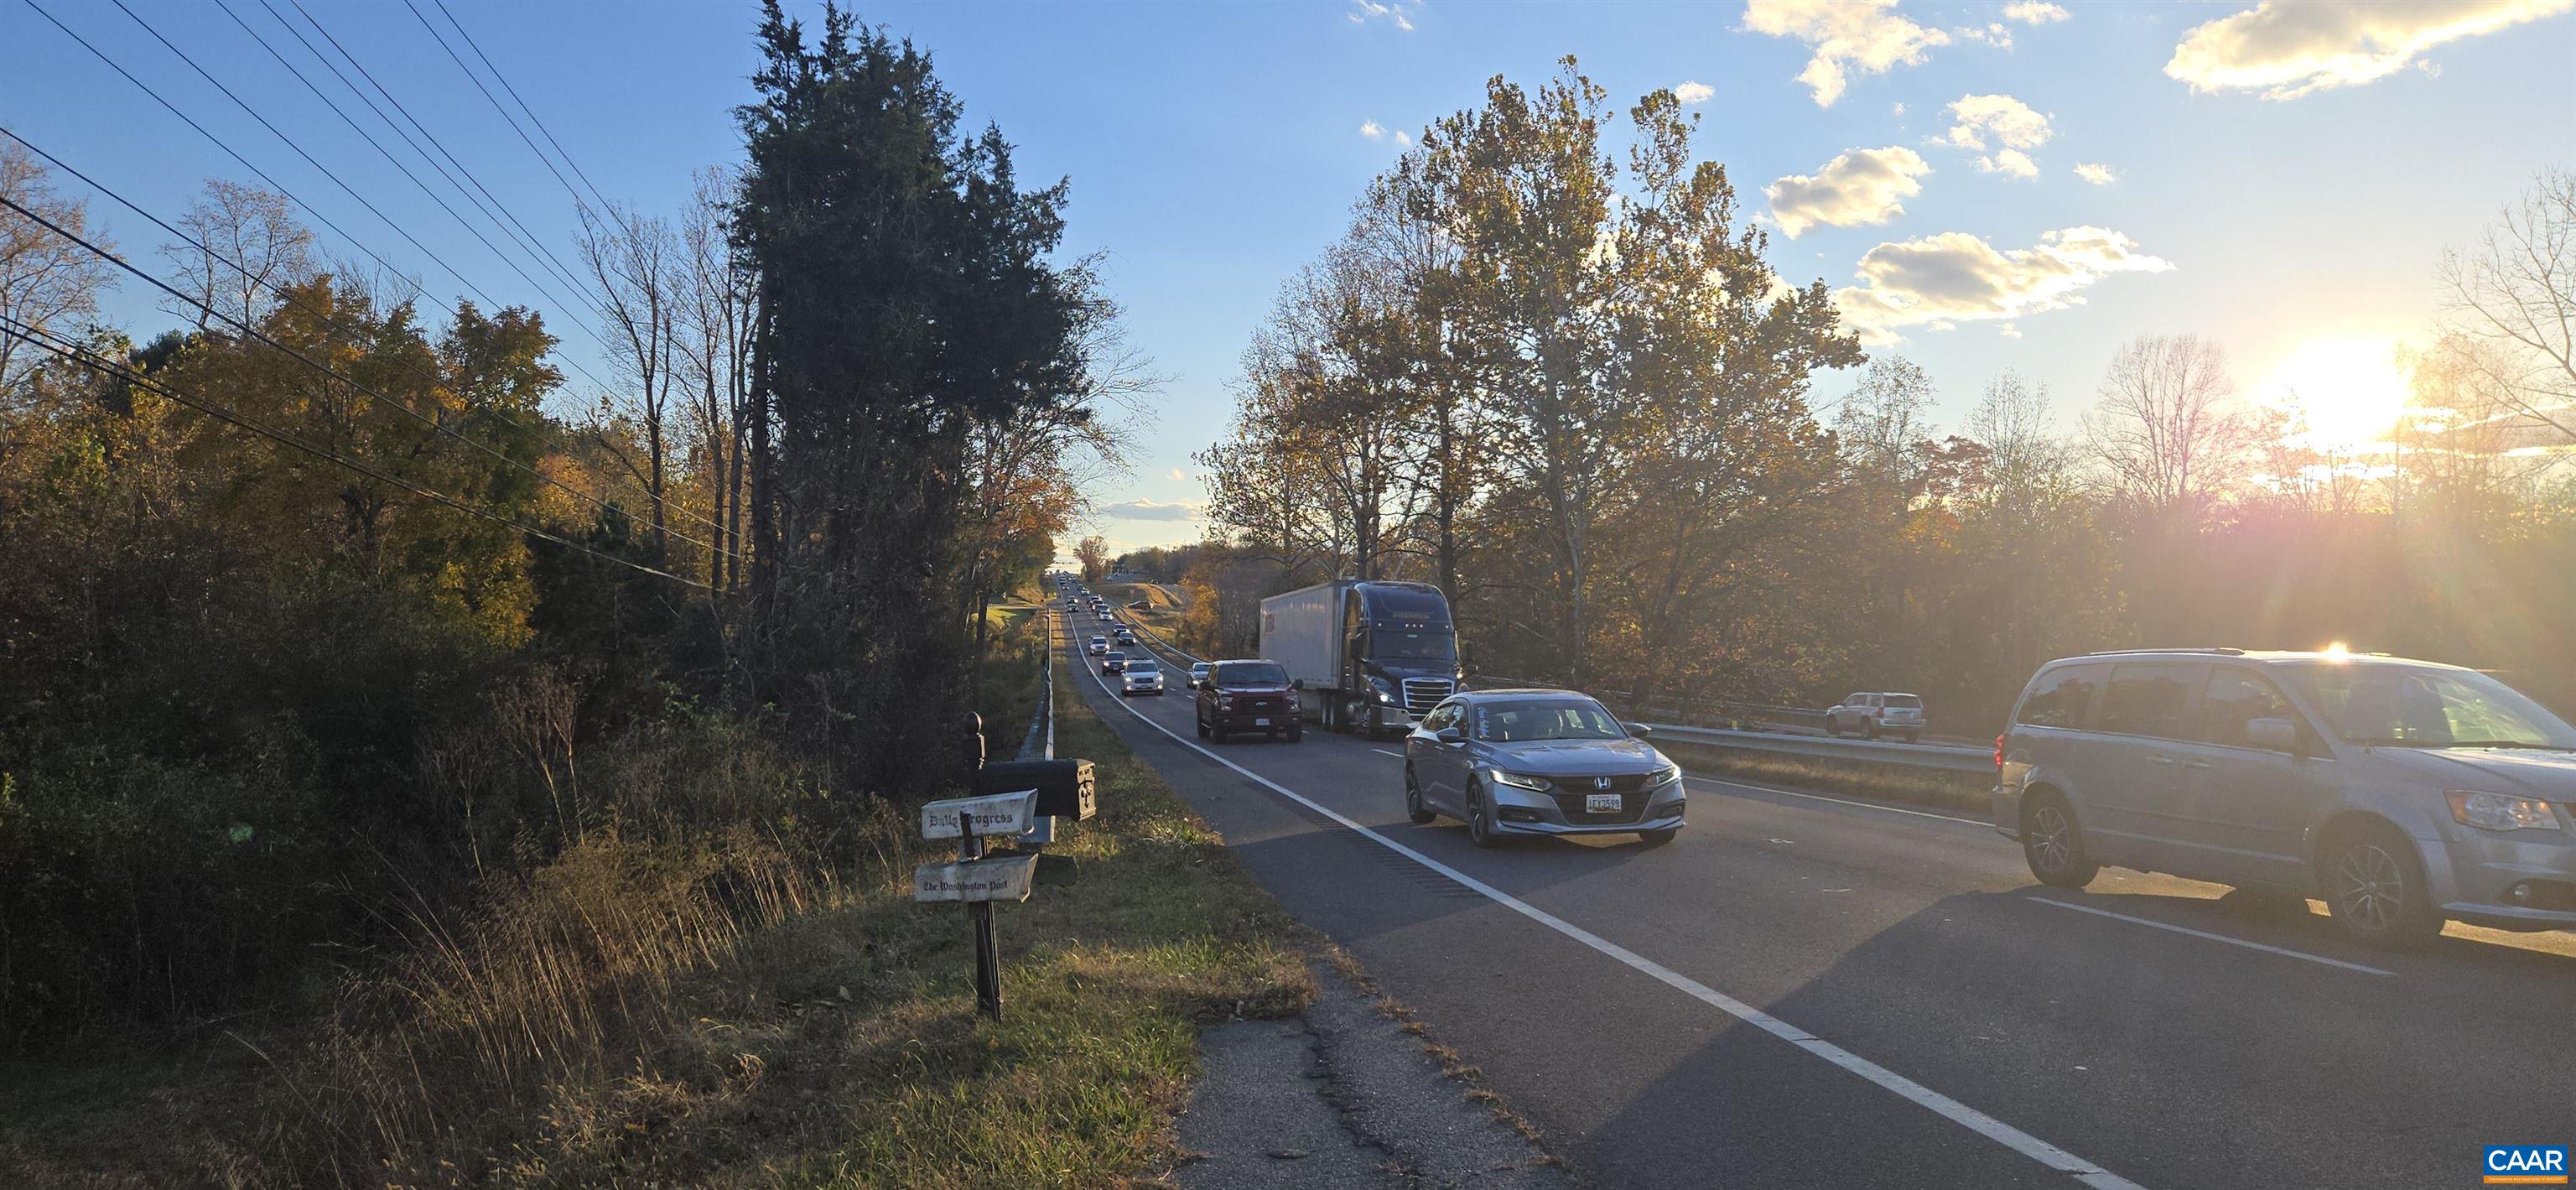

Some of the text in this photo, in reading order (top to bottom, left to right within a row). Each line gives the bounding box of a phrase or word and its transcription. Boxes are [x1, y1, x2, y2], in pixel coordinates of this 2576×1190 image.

[969, 814, 1013, 828] rogress
[924, 879, 1008, 892] The Washington Post
